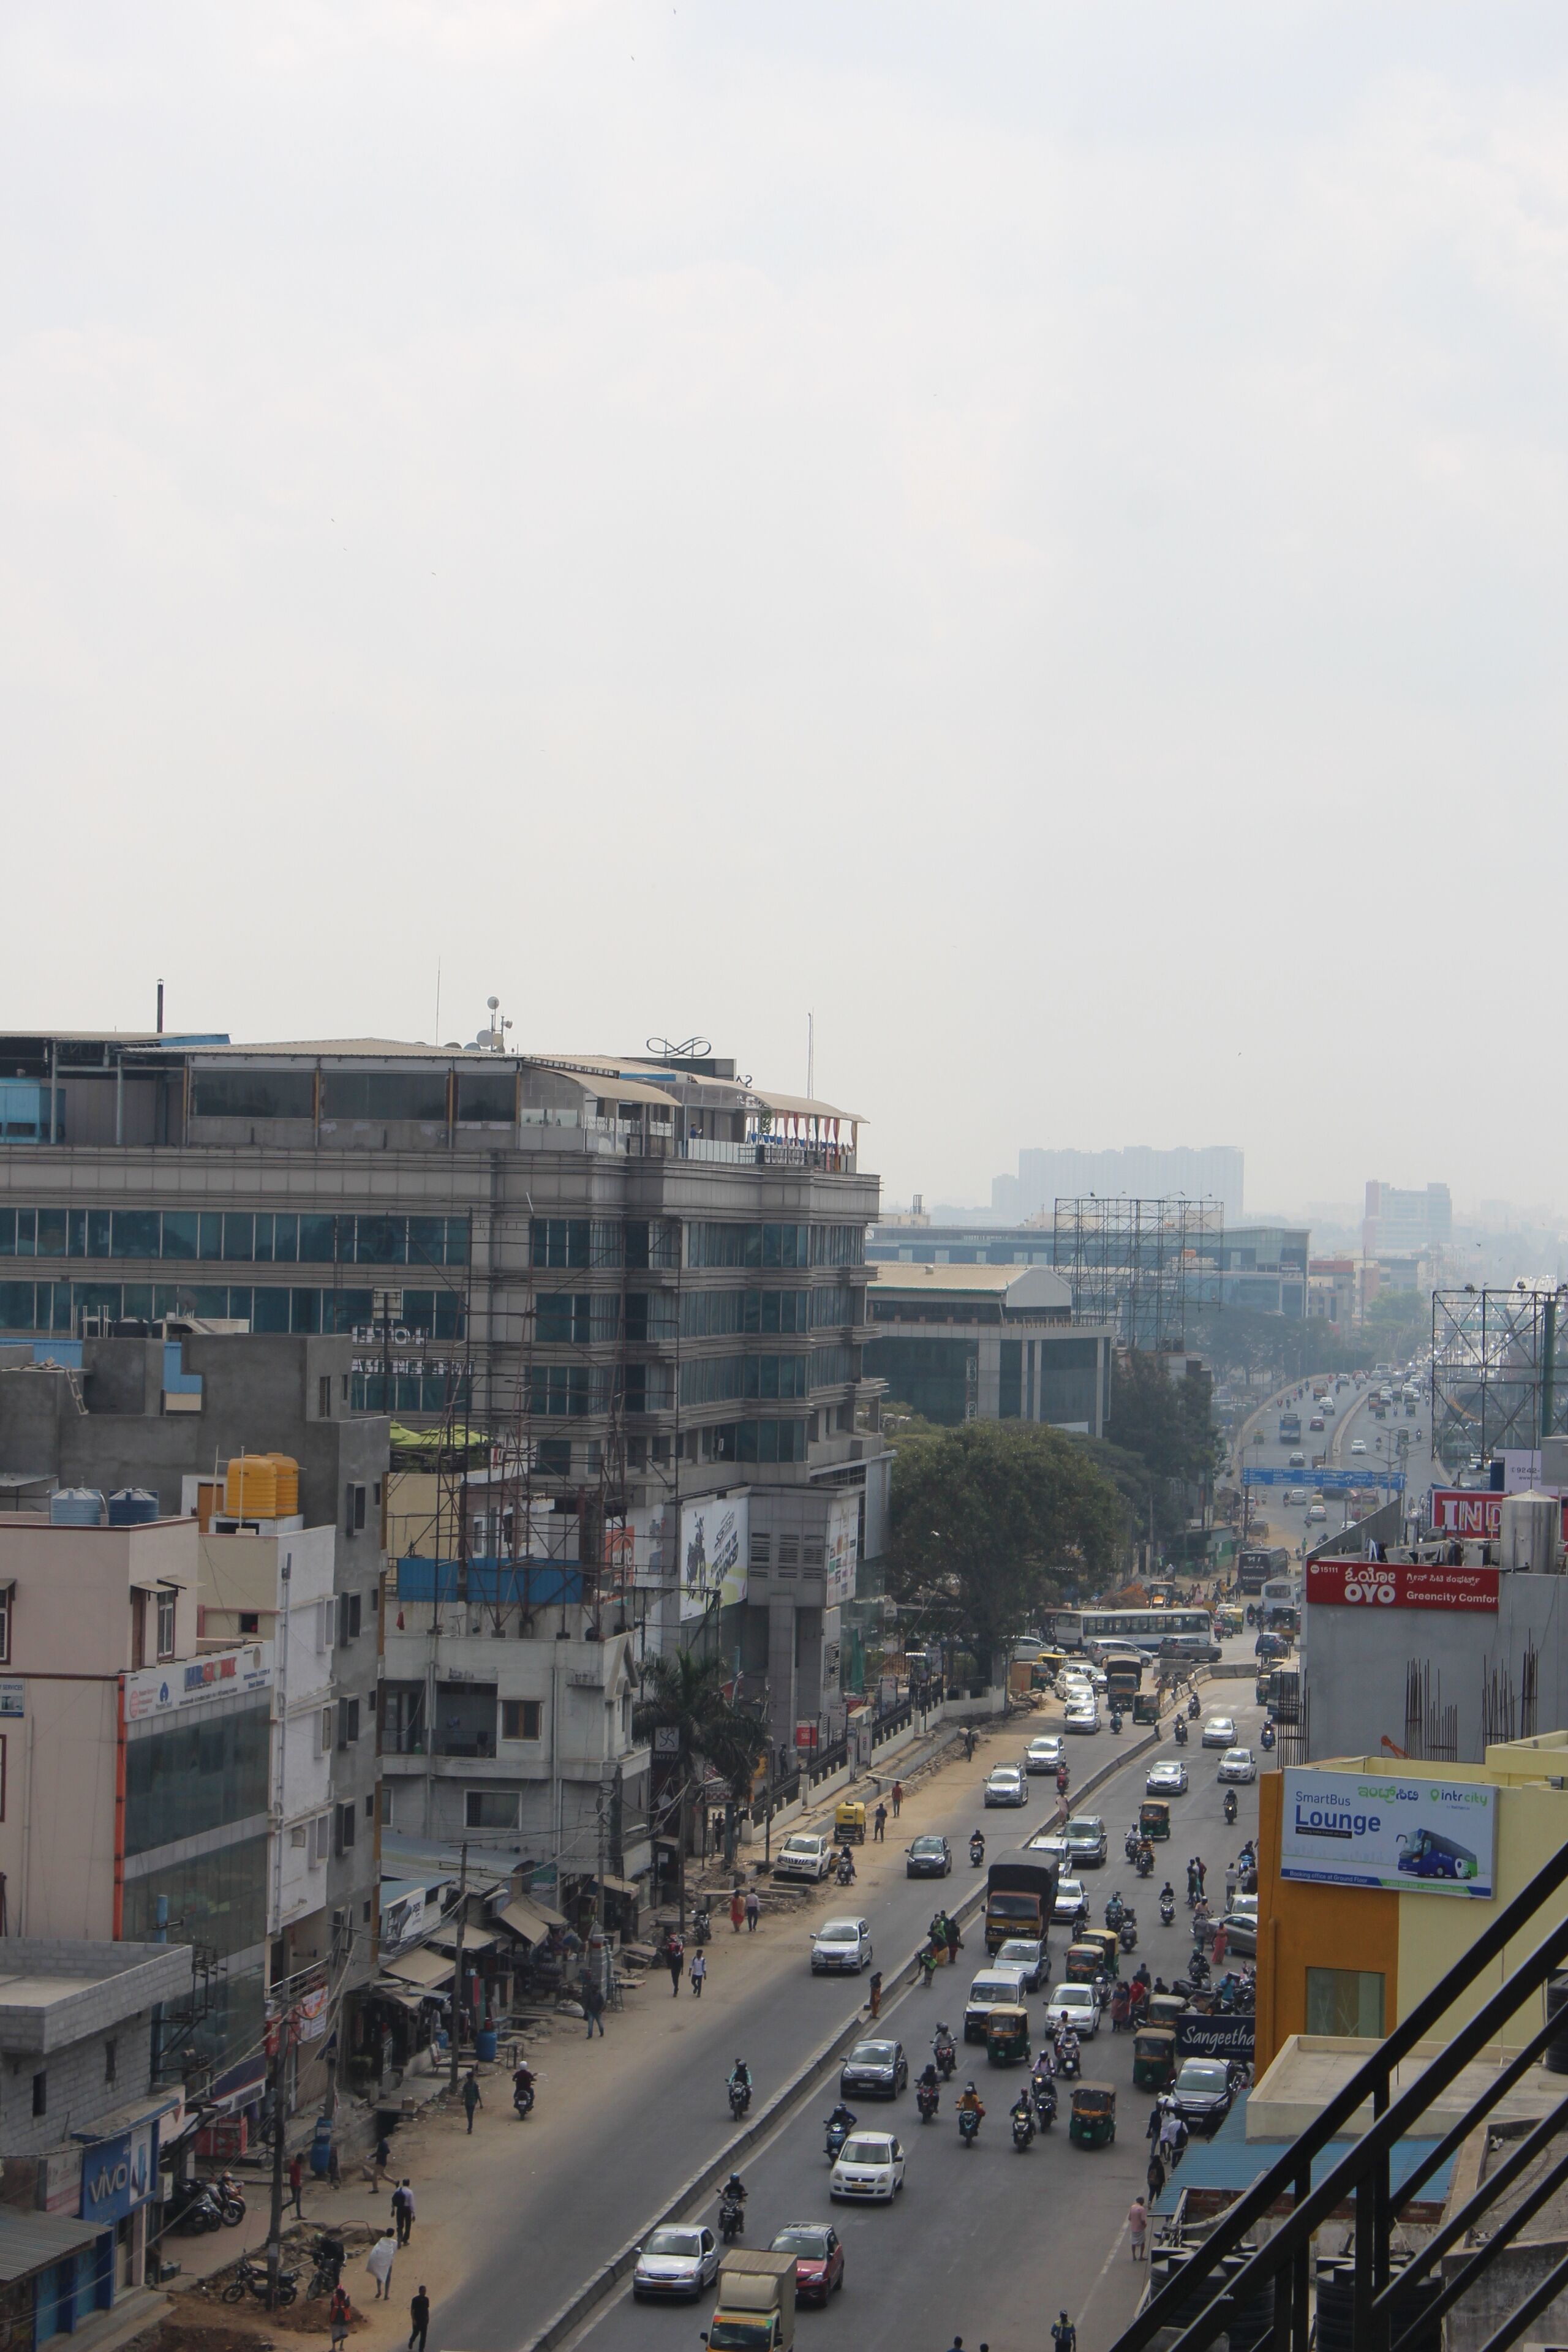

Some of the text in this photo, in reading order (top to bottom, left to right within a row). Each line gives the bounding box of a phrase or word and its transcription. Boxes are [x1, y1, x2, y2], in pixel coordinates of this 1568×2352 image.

[1344, 1583, 1395, 1604] OYO
[1406, 1591, 1457, 1603] Greencity
[1295, 1791, 1351, 1806] SmartBus
[1295, 1805, 1381, 1836] Lounge
[1290, 1870, 1311, 1879] Booking
[1182, 2025, 1255, 2054] Sangeetha
